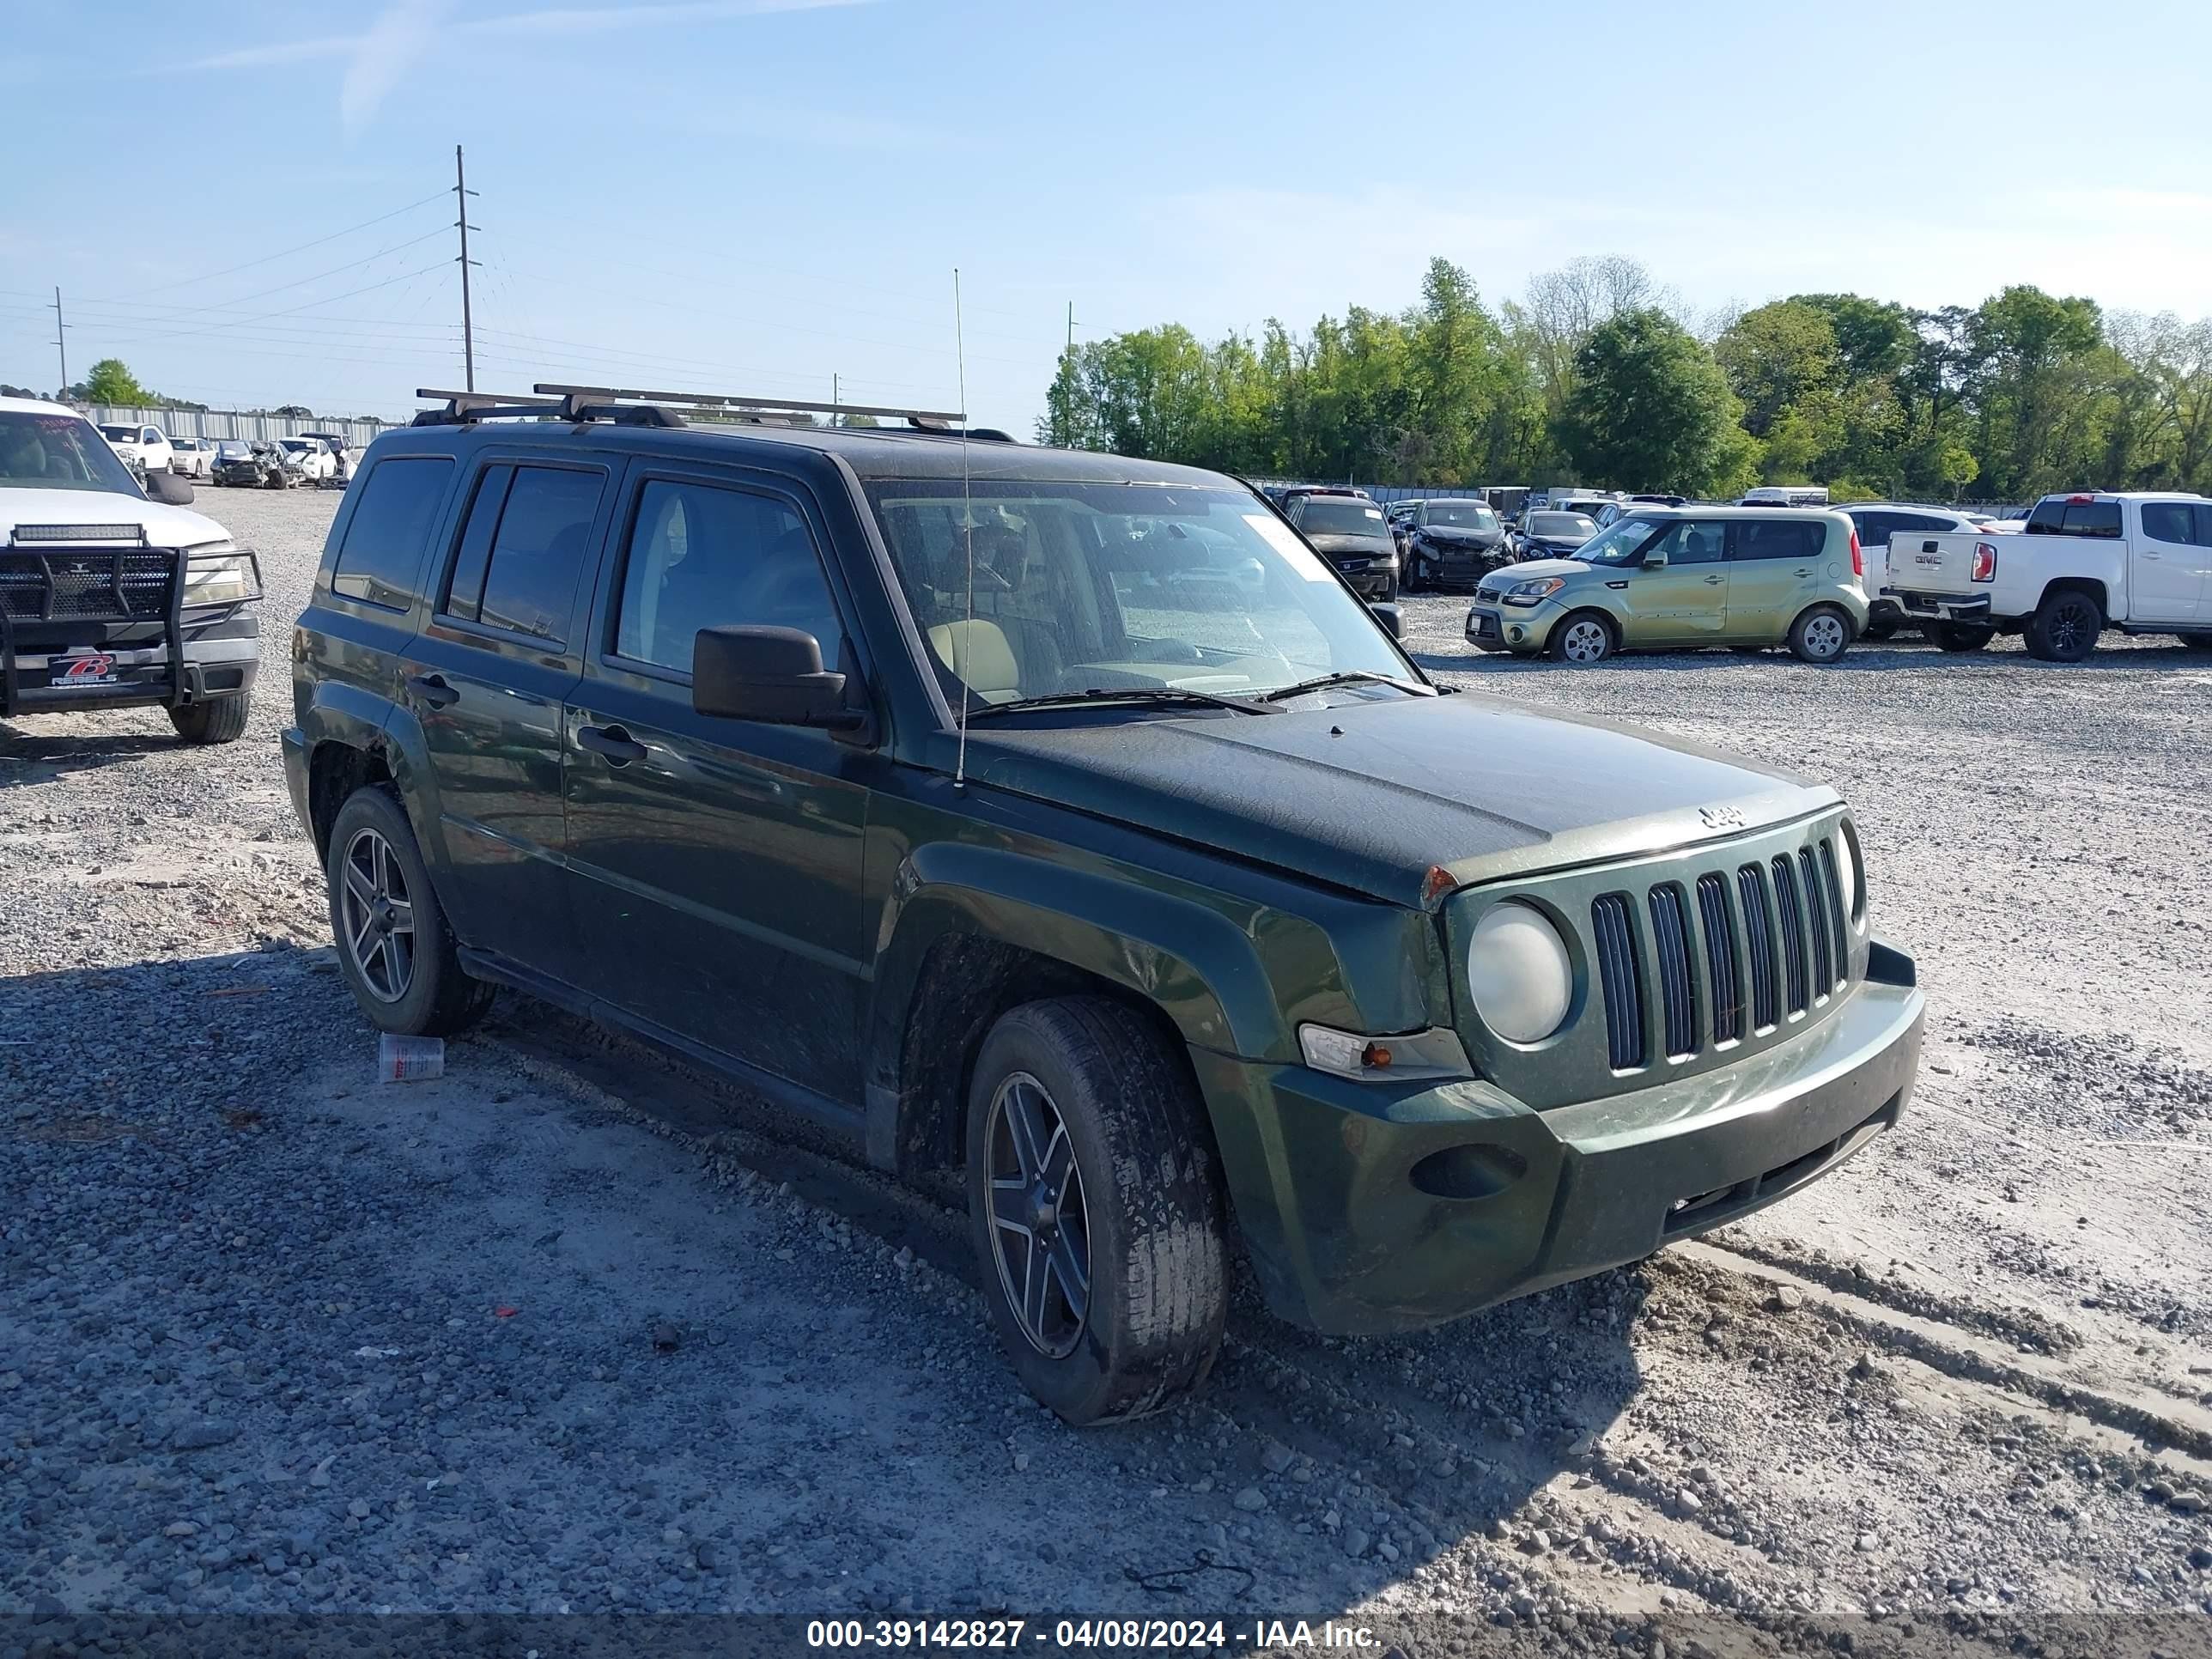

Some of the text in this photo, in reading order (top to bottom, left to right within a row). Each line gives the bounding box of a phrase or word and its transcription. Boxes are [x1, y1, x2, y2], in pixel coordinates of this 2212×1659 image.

[1915, 556, 1942, 565] GMC
[52, 674, 118, 685] REBELS
[1698, 805, 1747, 829] Jeep
